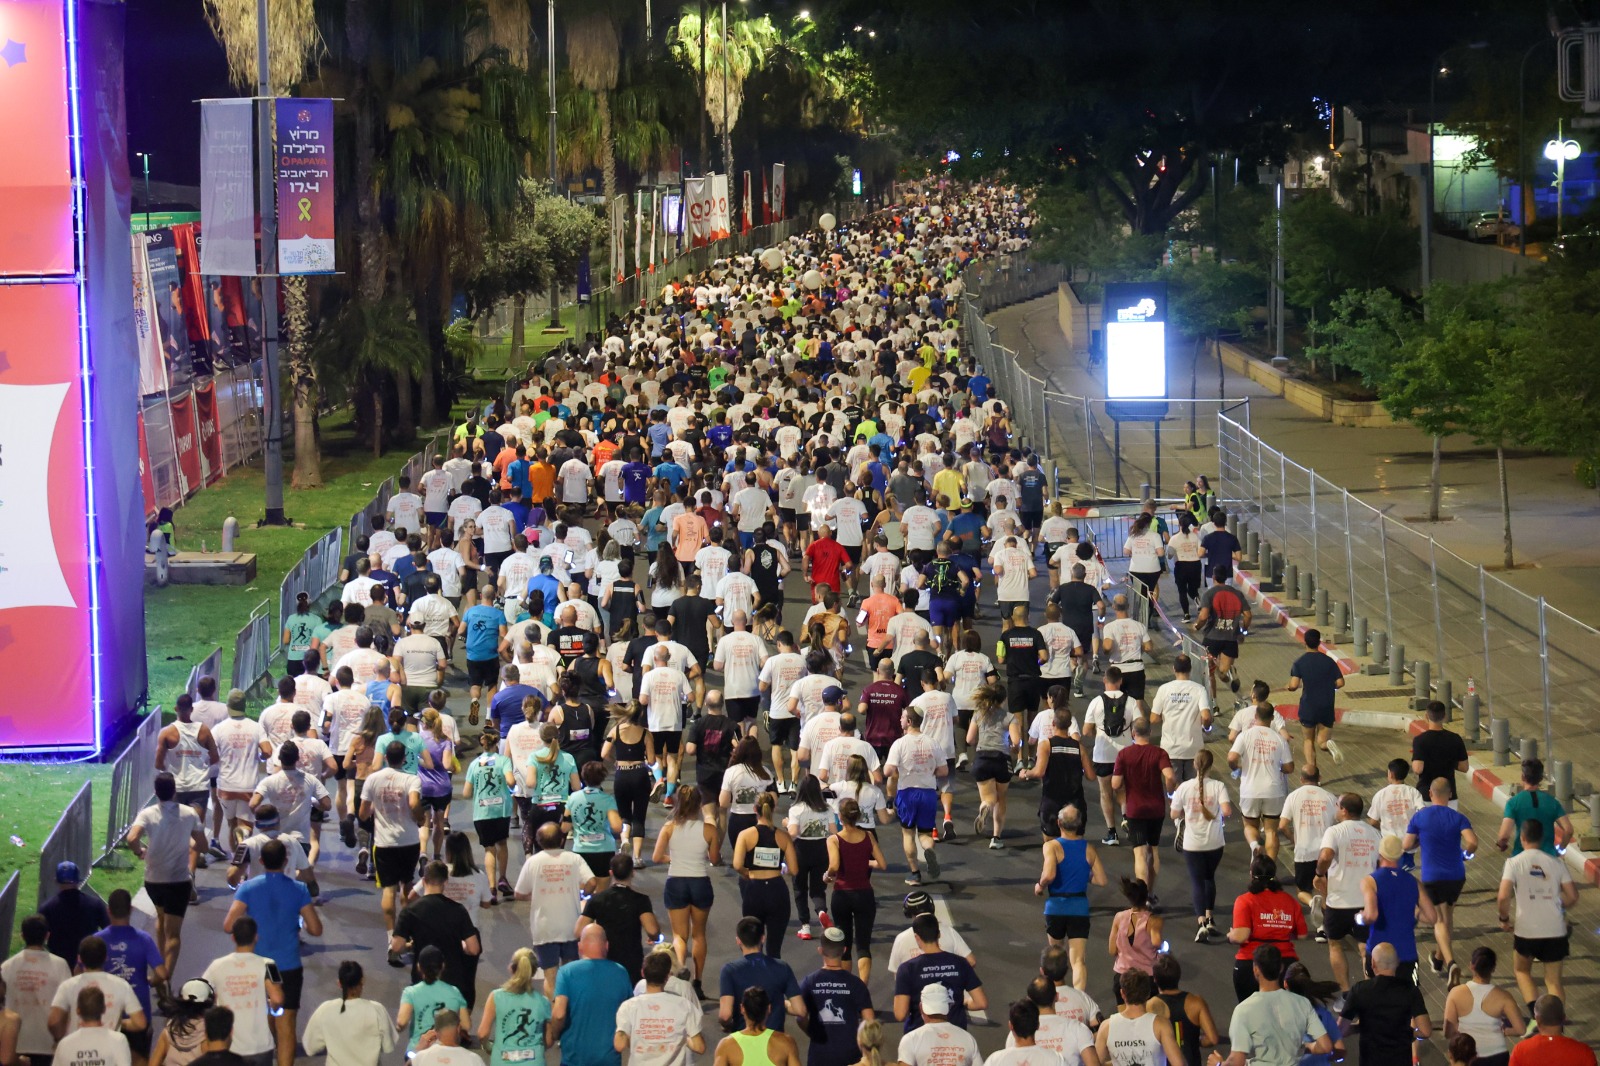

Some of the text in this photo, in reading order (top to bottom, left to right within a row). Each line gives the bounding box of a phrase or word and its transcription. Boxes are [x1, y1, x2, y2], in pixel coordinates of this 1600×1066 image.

[282, 143, 326, 154] הלילה
[289, 182, 320, 193] 17.4
[77, 1049, 99, 1059] רצים
